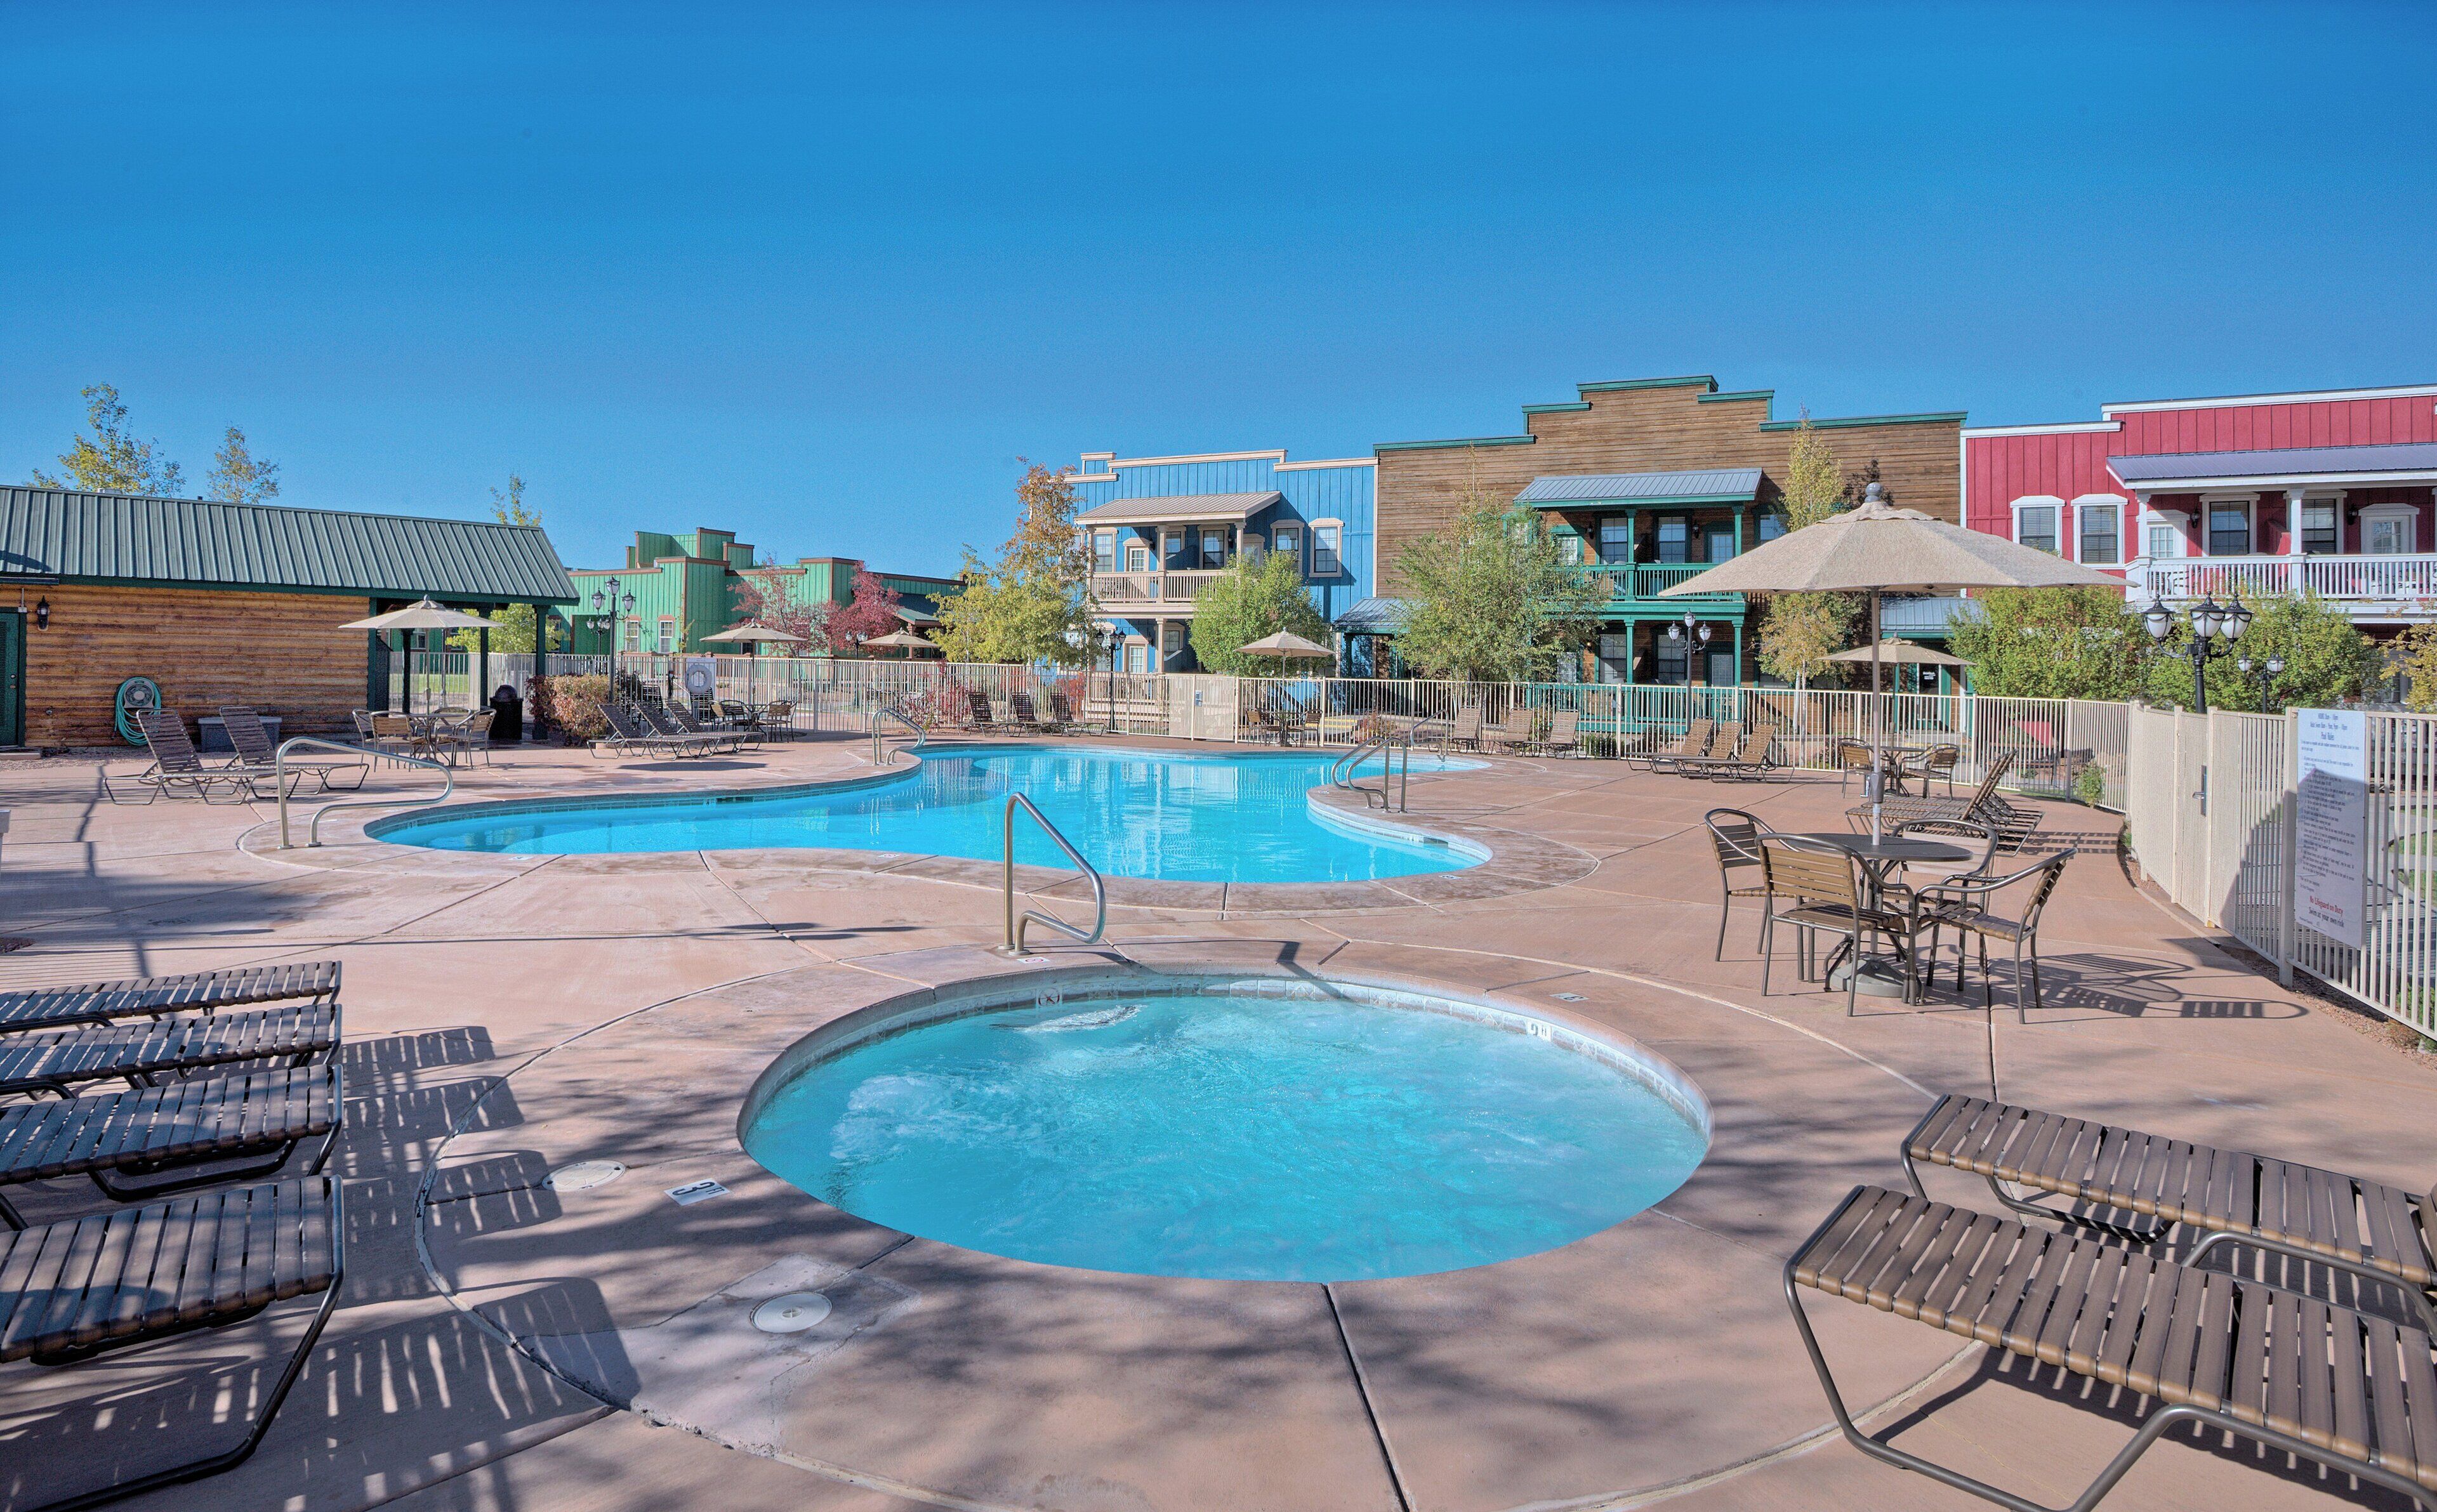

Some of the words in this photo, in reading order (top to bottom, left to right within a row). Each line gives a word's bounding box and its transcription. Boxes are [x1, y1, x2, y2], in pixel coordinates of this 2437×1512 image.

[2309, 895, 2314, 904] No
[2315, 897, 2329, 909] Lifeguard
[2335, 905, 2343, 917] Duty
[672, 1181, 715, 1195] 3
[705, 1187, 725, 1195] FT
